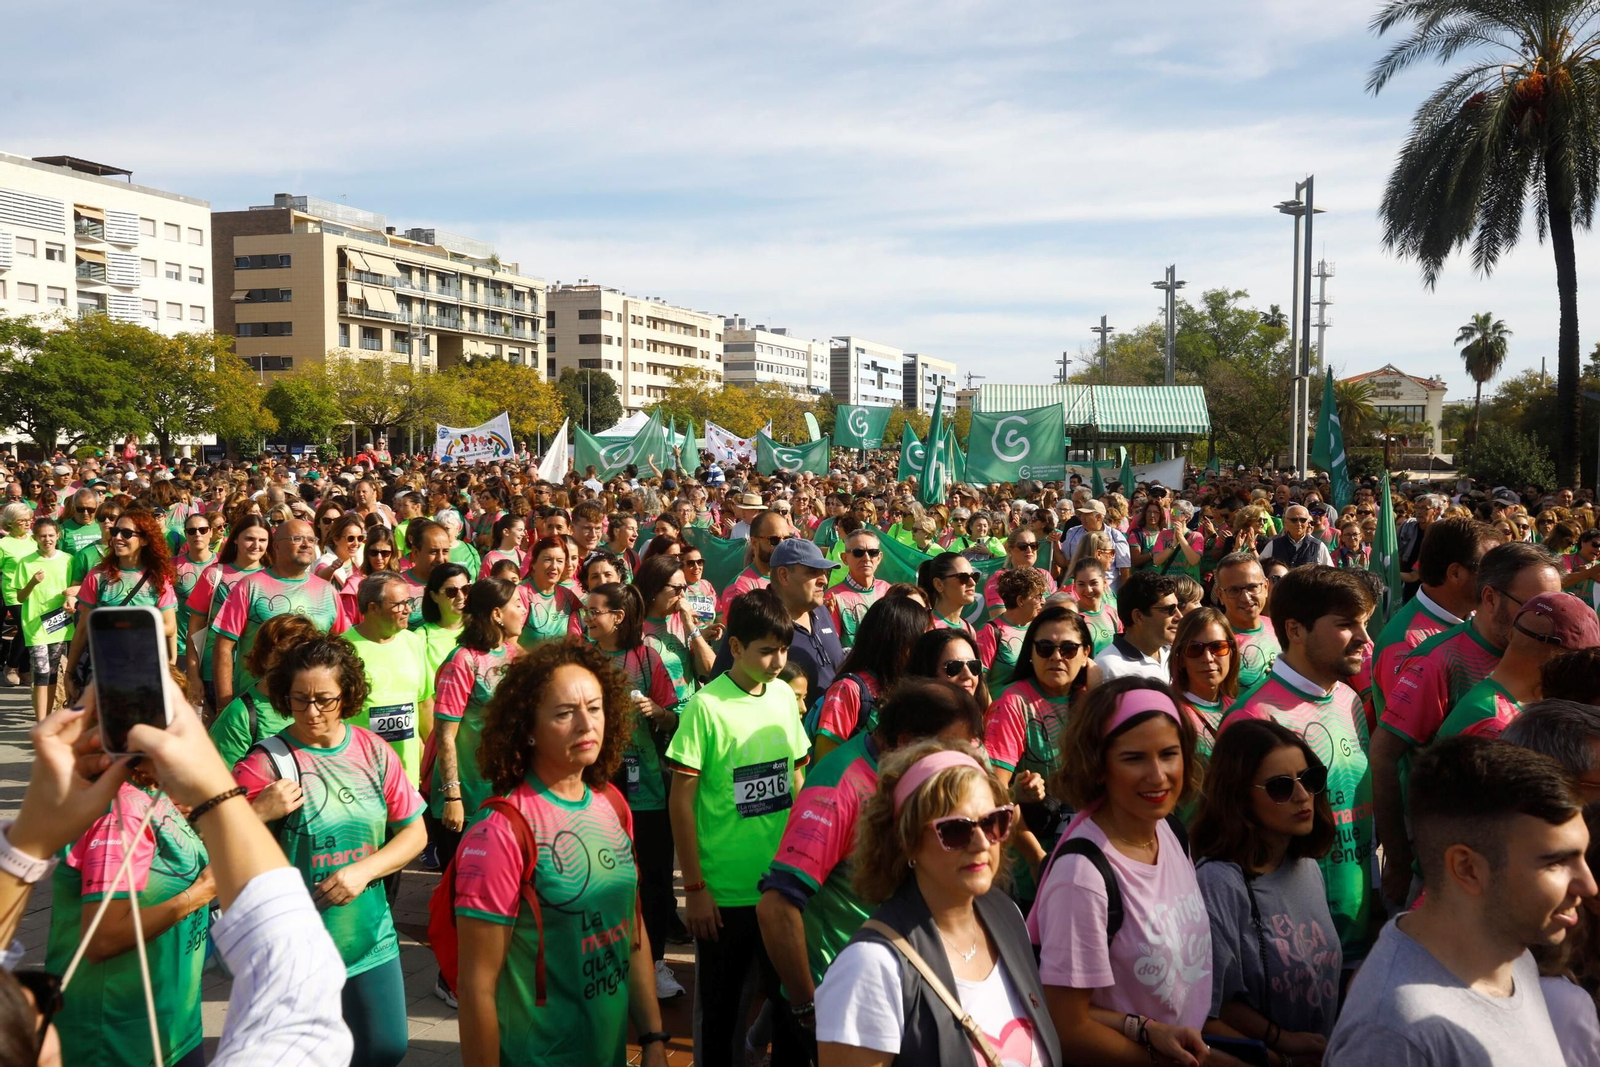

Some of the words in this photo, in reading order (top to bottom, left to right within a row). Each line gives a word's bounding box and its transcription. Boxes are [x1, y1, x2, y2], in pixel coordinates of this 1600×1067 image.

[377, 716, 410, 731] 2060
[744, 776, 785, 800] 2916
[312, 834, 337, 851] La
[582, 910, 604, 932] La
[583, 949, 615, 980] que
[1137, 961, 1165, 977] doy
